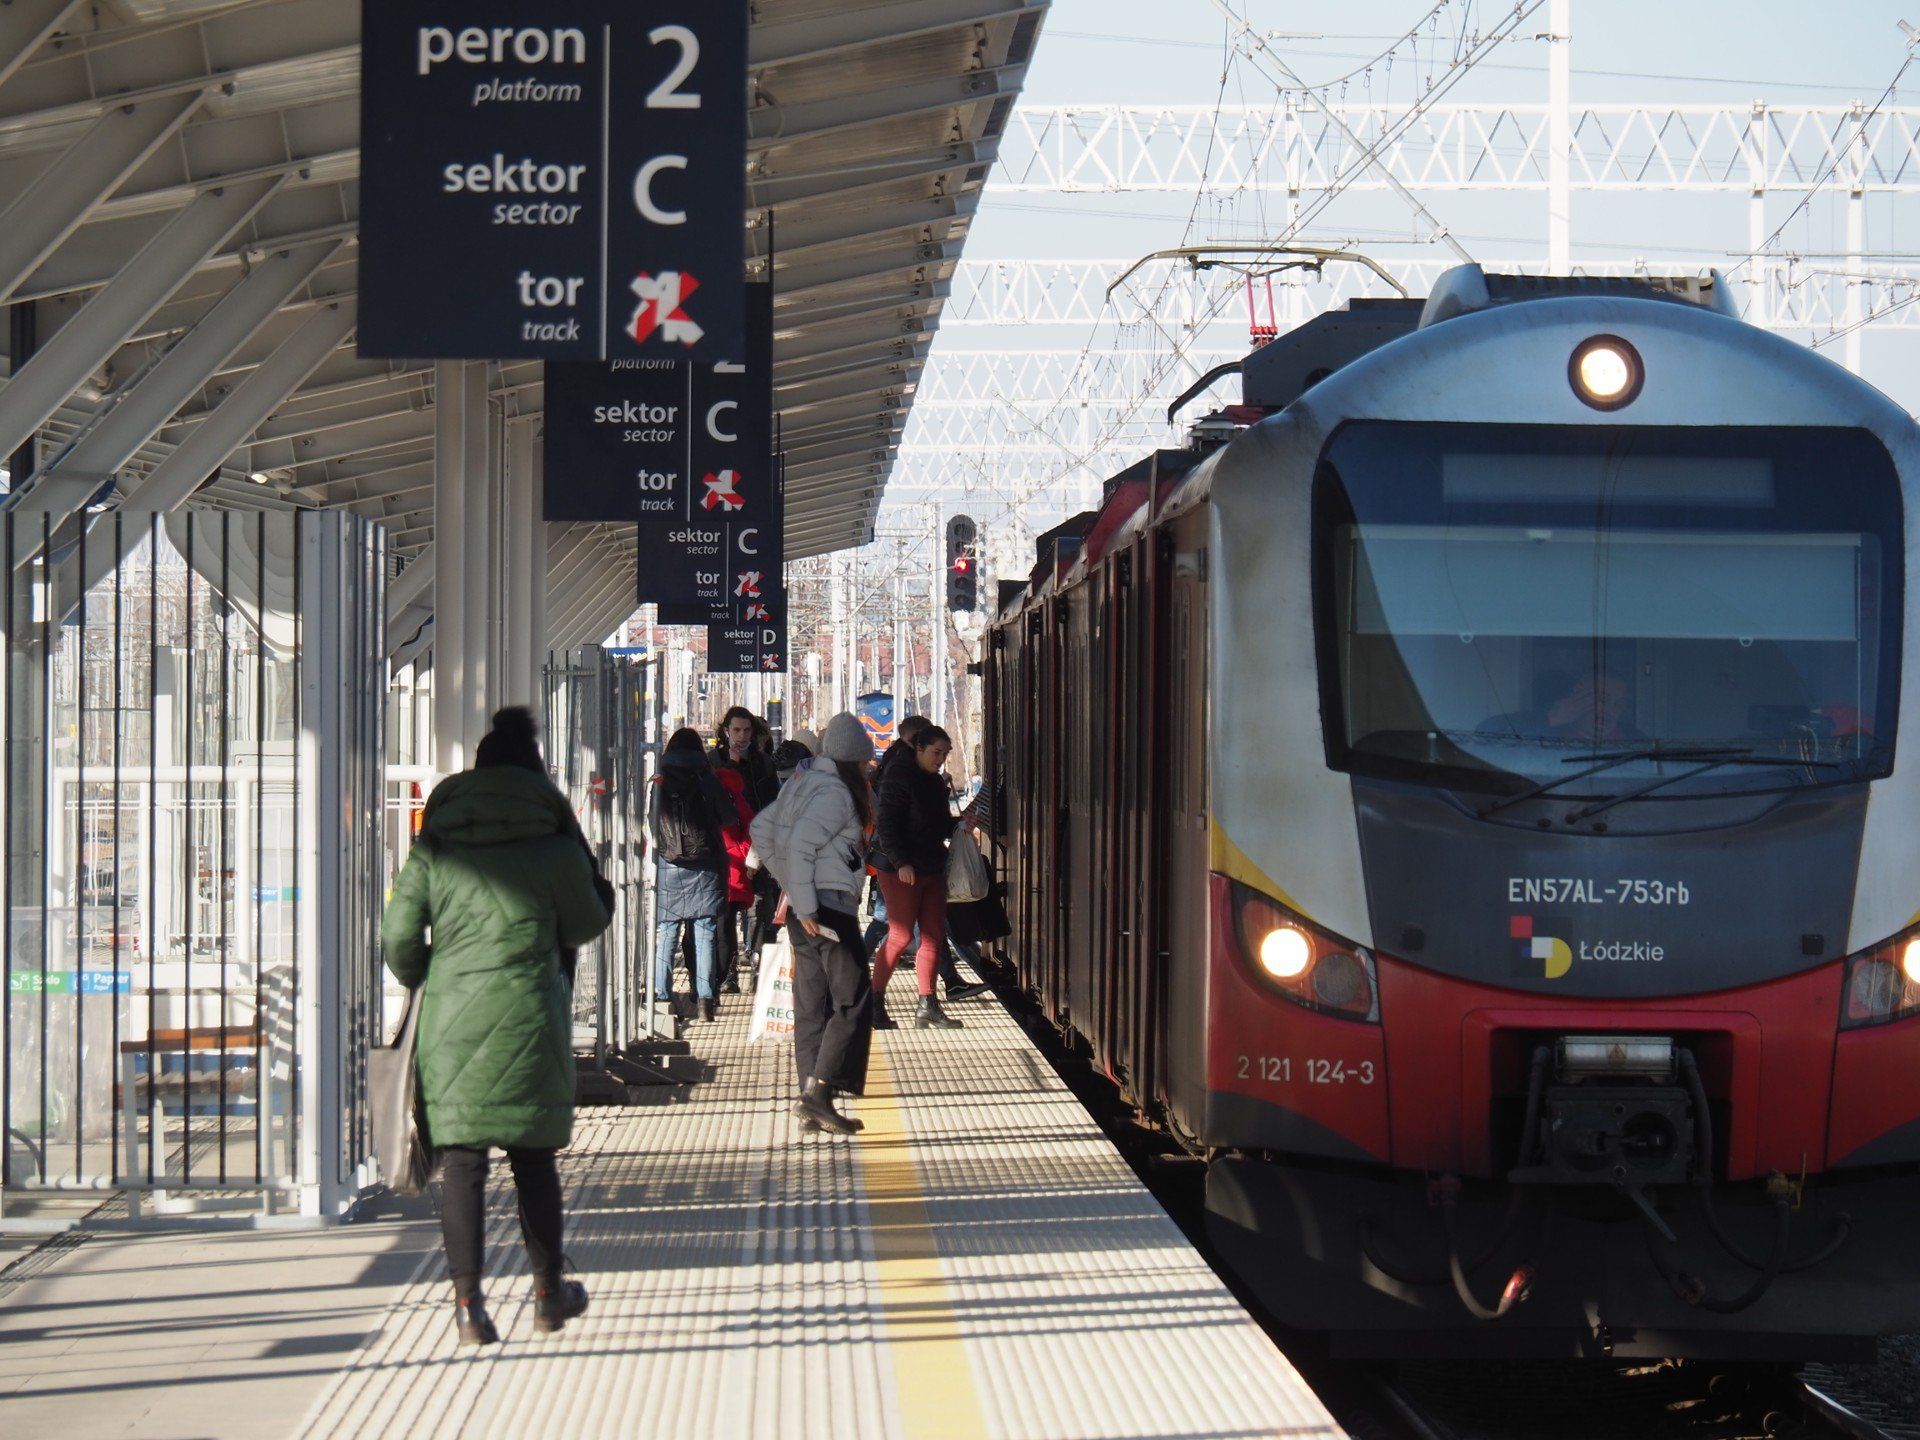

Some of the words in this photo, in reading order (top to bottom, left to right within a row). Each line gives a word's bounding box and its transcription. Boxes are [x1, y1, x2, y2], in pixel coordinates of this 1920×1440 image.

[417, 26, 586, 75] peron
[645, 25, 702, 109] 2
[471, 78, 582, 107] platform
[443, 153, 587, 193] sektor
[633, 154, 688, 225] C
[492, 201, 582, 225] sector
[517, 270, 585, 307] tor
[521, 318, 580, 342] track
[594, 400, 678, 423] sektor
[706, 400, 739, 442] C
[623, 428, 676, 443] sector
[637, 469, 678, 491] tor
[640, 497, 675, 511] track
[668, 527, 721, 543] sektor
[737, 528, 759, 555] C
[686, 545, 719, 555] sector
[695, 570, 720, 585] tor
[697, 588, 719, 597] track
[711, 610, 730, 619] track
[724, 629, 755, 639] sektor
[762, 629, 777, 645] D
[739, 653, 755, 662] tor
[1508, 878, 1690, 905] EN57AL-753rb
[1579, 940, 1664, 962] Łódzkie
[93, 973, 129, 985] Paper
[1237, 1055, 1250, 1080] 2
[1259, 1056, 1291, 1082] 121
[1306, 1058, 1374, 1085] 124-3
